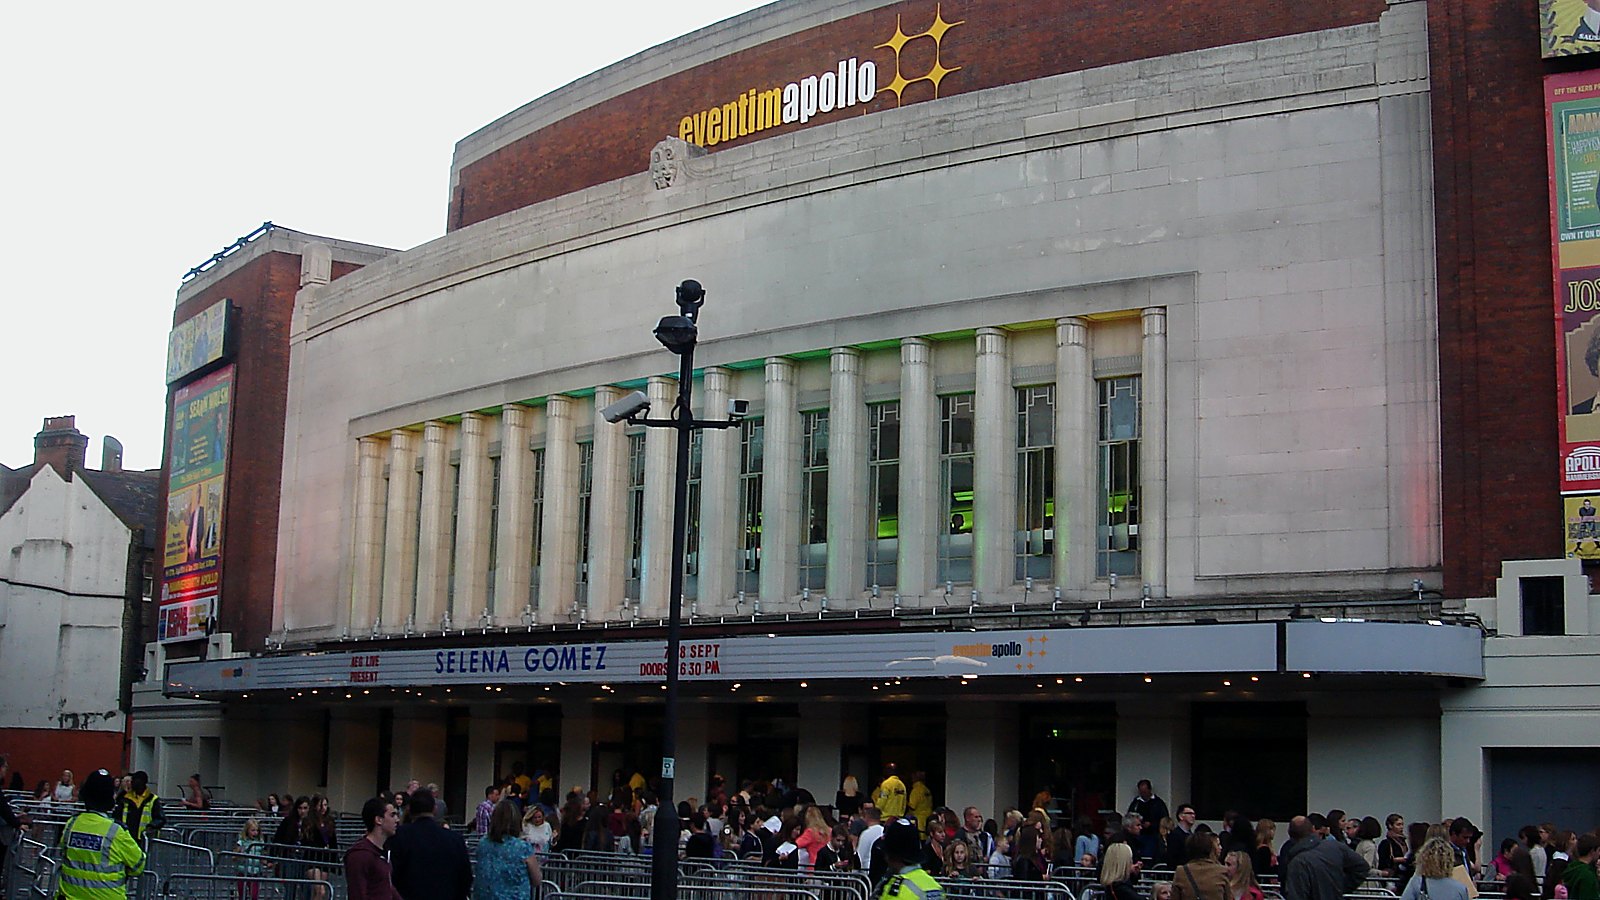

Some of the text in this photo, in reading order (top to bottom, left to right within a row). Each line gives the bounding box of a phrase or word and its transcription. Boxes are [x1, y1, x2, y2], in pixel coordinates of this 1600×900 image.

[1554, 87, 1565, 96] OFF
[1566, 86, 1577, 94] THE
[1561, 232, 1576, 240] OWN
[1577, 231, 1584, 239] IT
[1585, 230, 1594, 238] ON
[680, 646, 686, 658] 8
[690, 644, 720, 658] SEPT
[366, 655, 379, 667] LIVE
[435, 646, 607, 674] SELENA GOMEZ
[640, 663, 669, 676] DOORS
[705, 661, 720, 674] PM
[350, 671, 378, 682] PRESENT
[71, 838, 99, 850] POLICE
